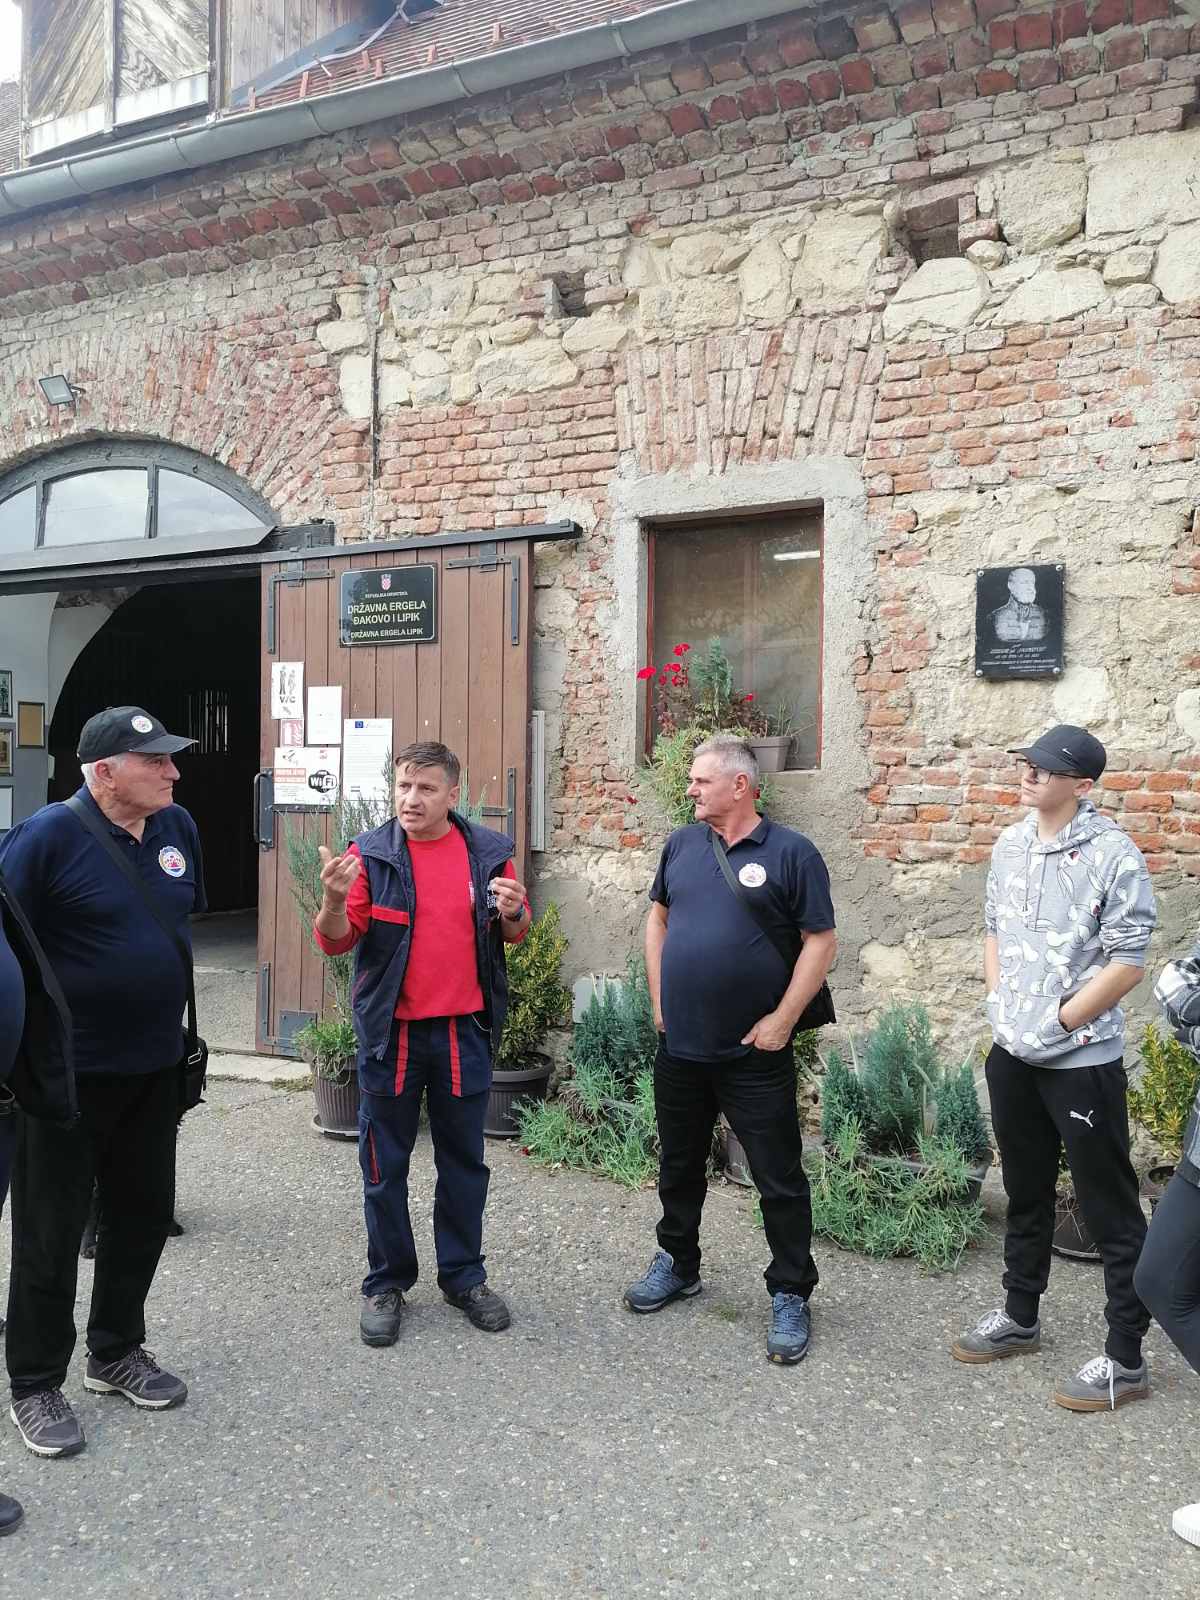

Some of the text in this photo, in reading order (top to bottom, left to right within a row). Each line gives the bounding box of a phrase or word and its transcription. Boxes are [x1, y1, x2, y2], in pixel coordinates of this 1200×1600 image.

[347, 600, 426, 614] DRŽAVNA ERGELA
[353, 614, 390, 625] ĐAKOVO
[397, 612, 420, 622] LIPIK
[350, 627, 424, 639] DRŽAVNA ERGELA LIPIK
